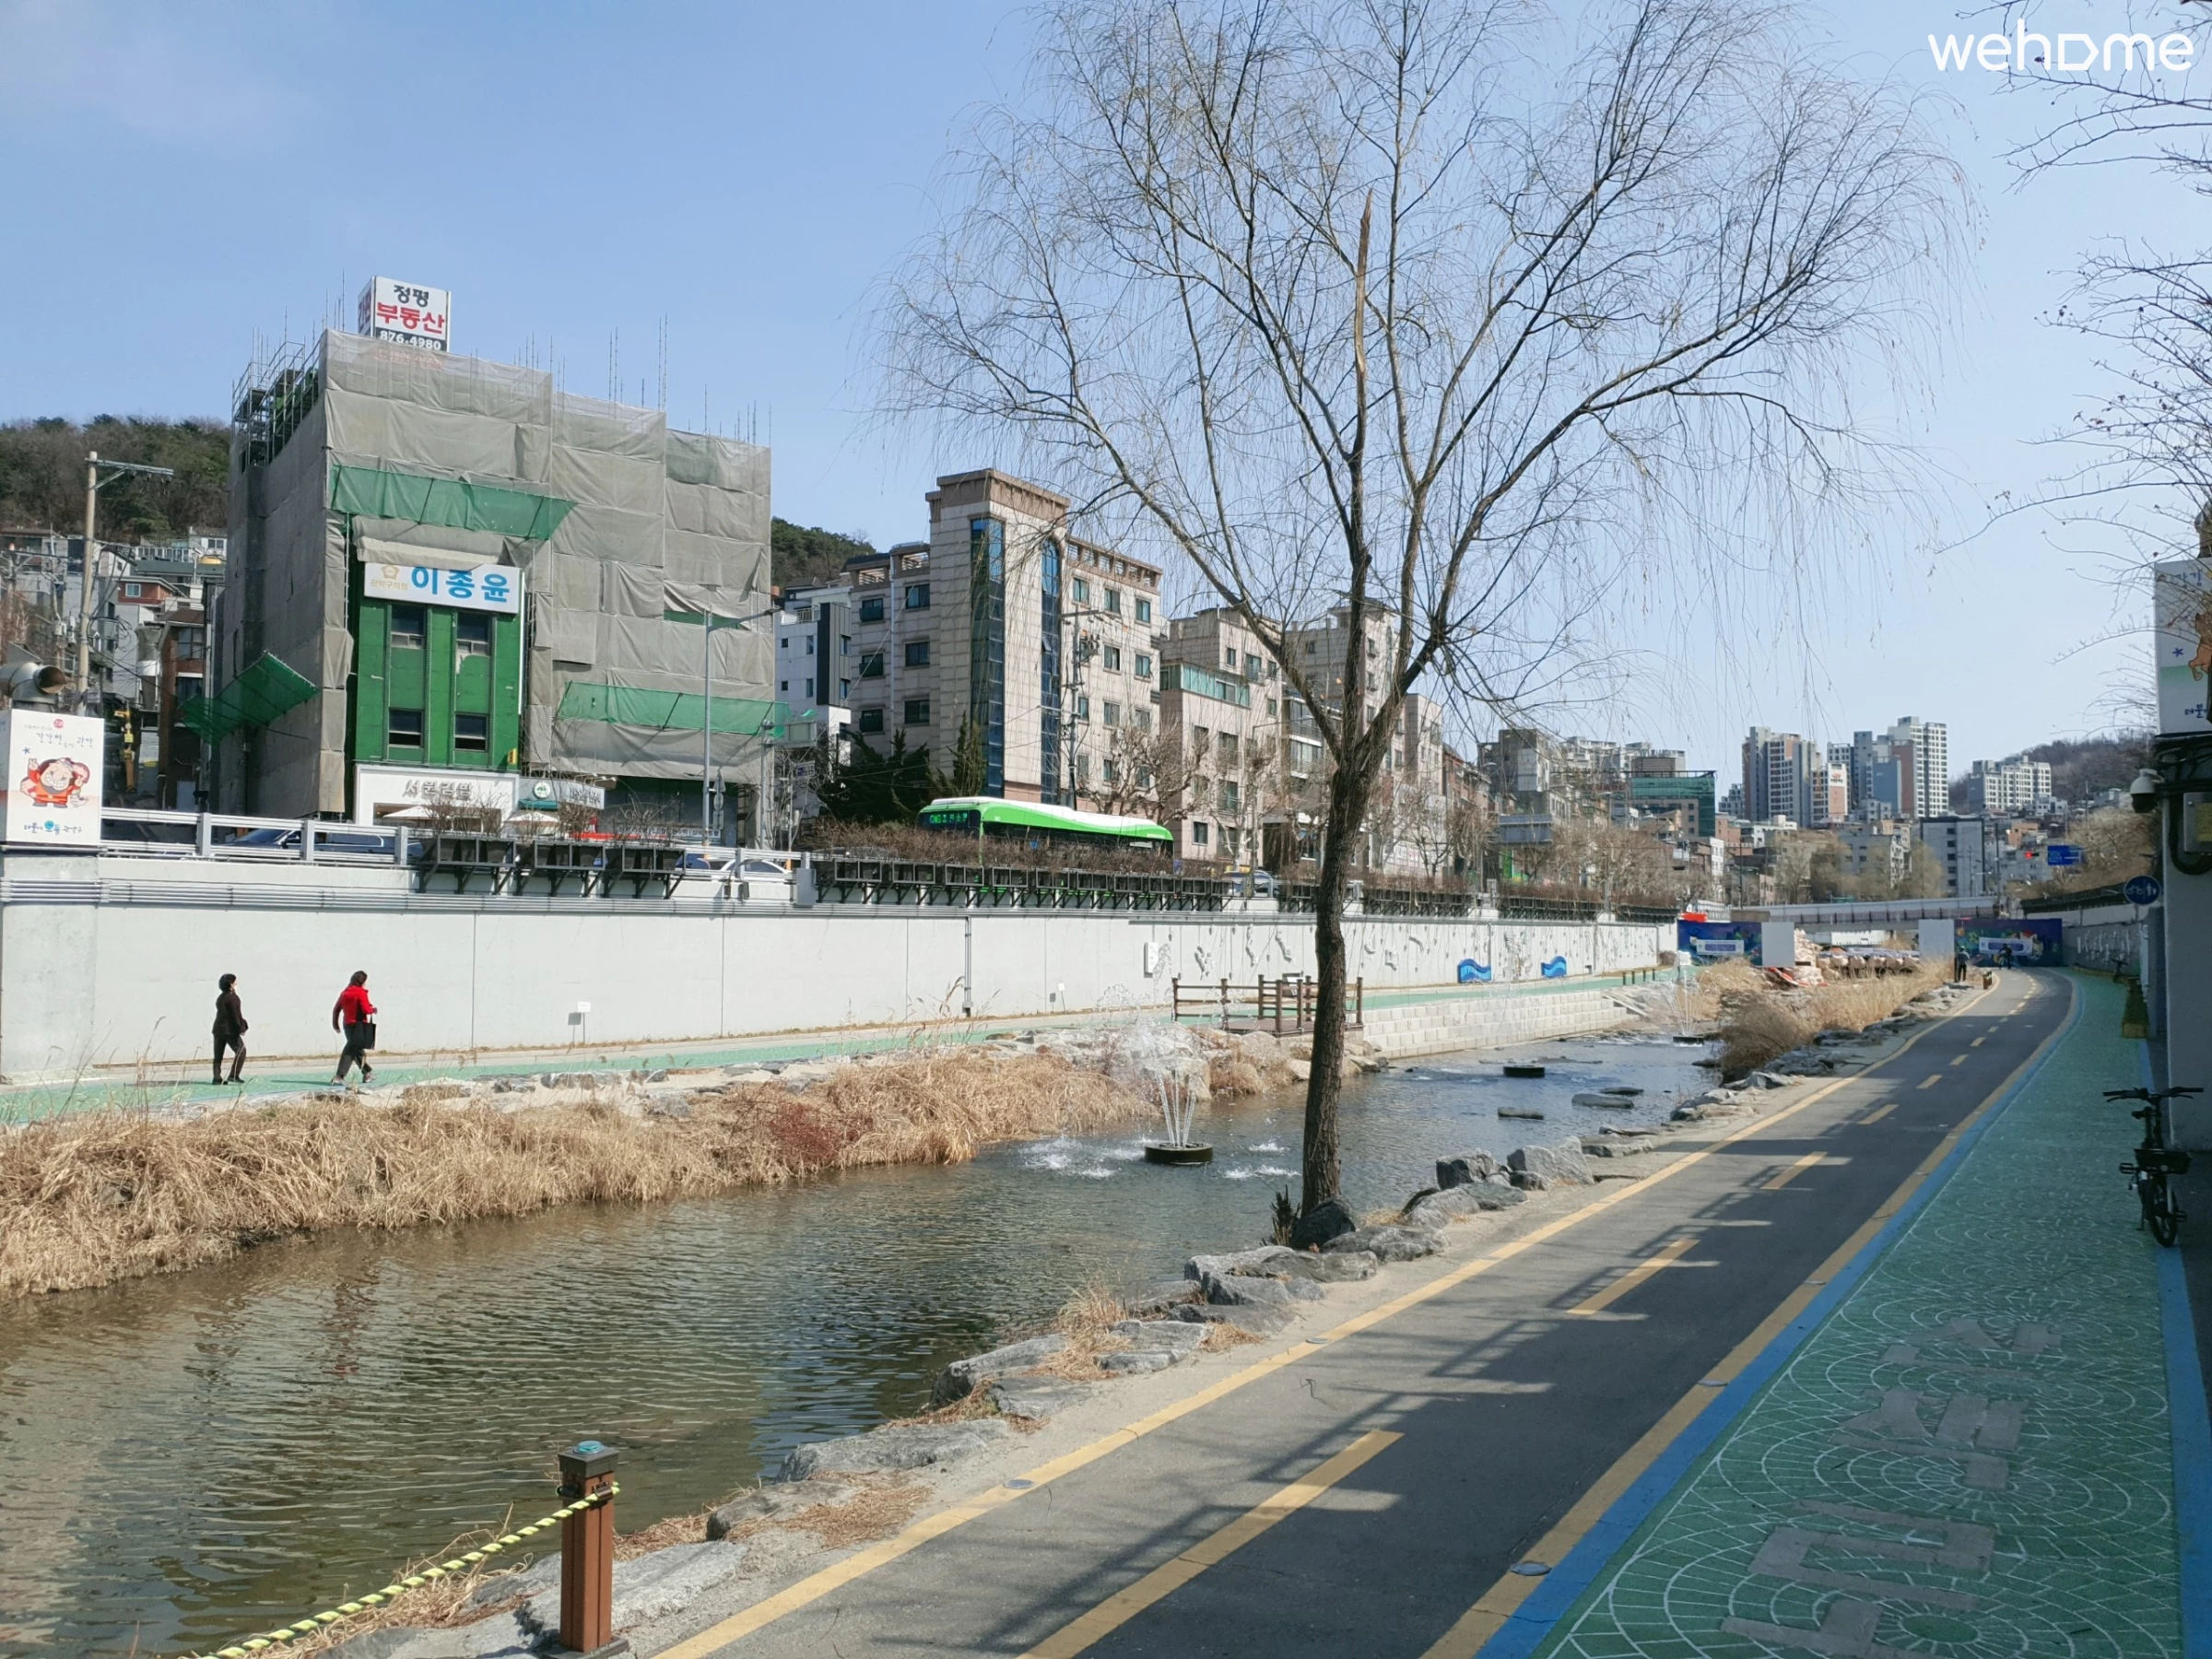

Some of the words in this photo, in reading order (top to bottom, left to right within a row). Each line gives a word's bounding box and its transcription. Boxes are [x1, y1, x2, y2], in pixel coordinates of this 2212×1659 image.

[394, 284, 429, 308] 정평
[376, 301, 445, 335] 부동산
[379, 330, 441, 350] 876.4980
[411, 566, 510, 603] 이종윤
[2184, 703, 2207, 719] 더불
[405, 779, 473, 797] 서원김밥
